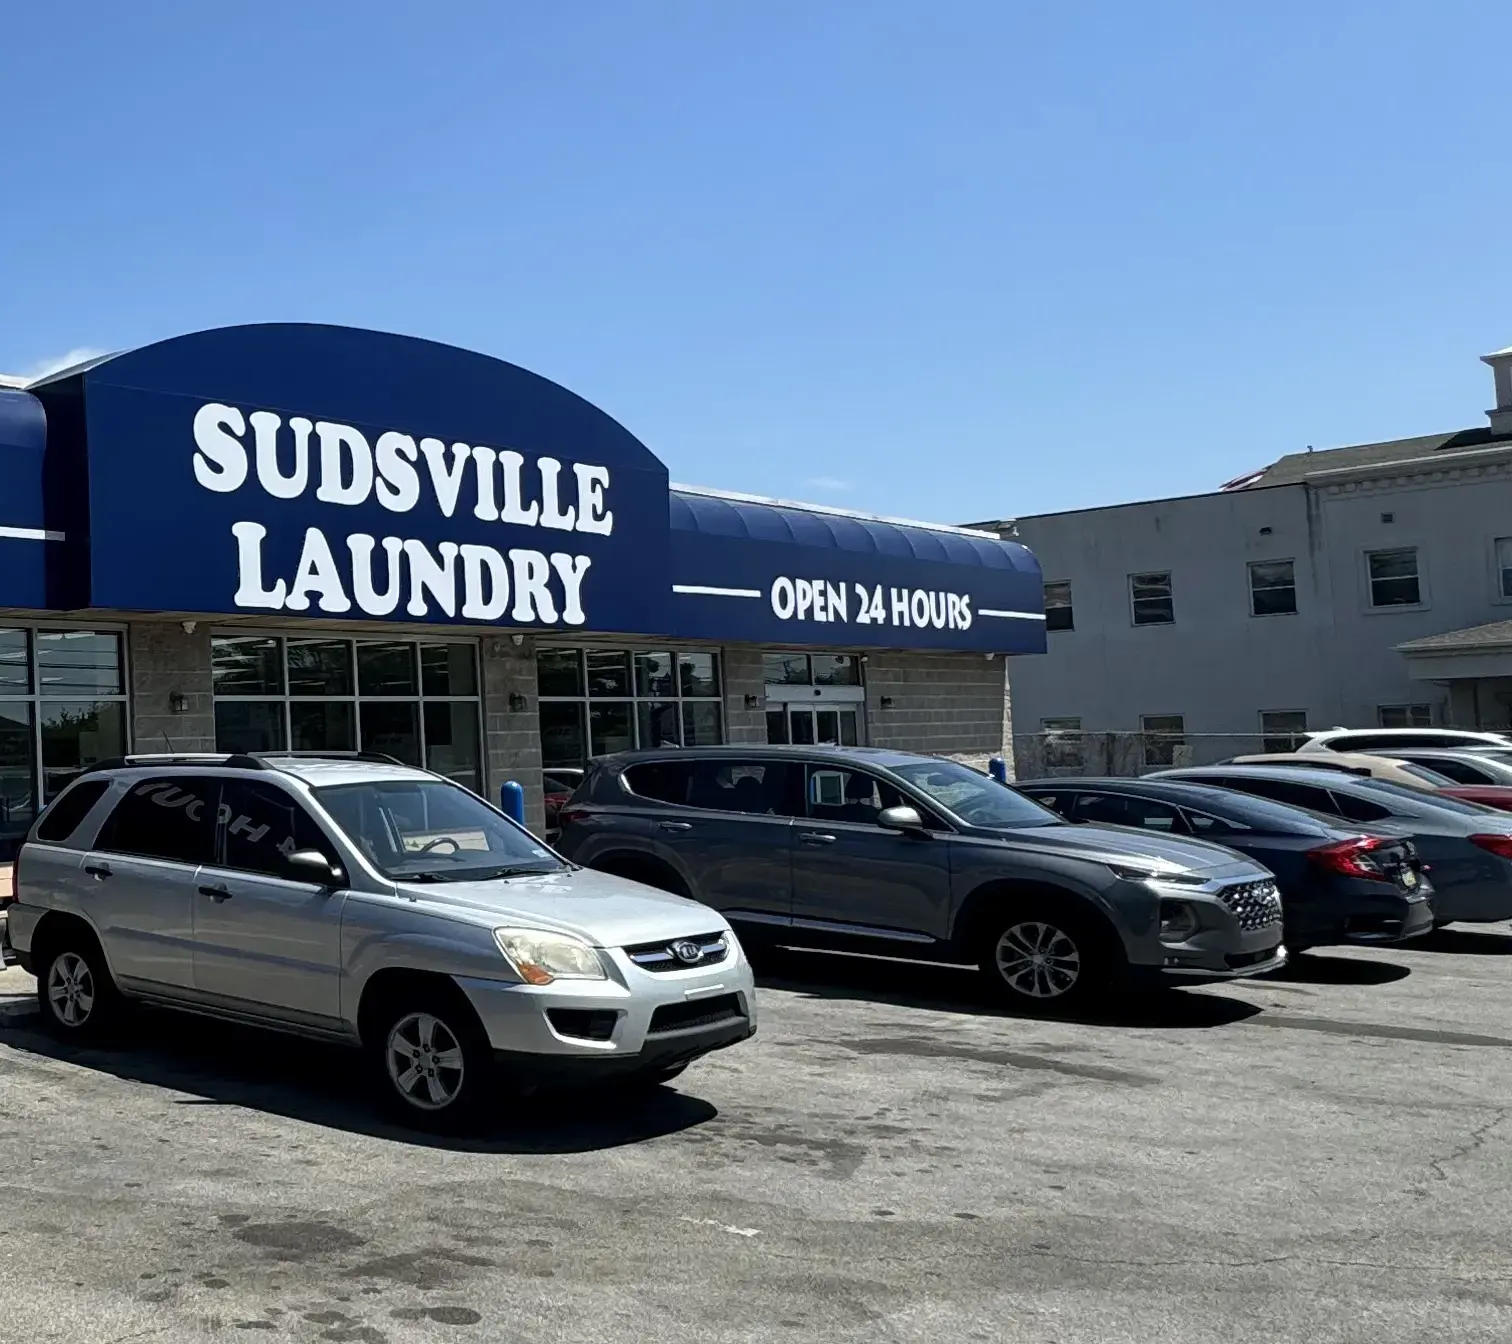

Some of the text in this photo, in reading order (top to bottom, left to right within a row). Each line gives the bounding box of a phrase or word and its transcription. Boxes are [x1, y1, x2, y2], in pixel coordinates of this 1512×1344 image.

[192, 402, 613, 537] SUDSVILLE
[231, 521, 592, 625] LAUNDRY
[771, 576, 973, 631] OPEN 24 HOURS
